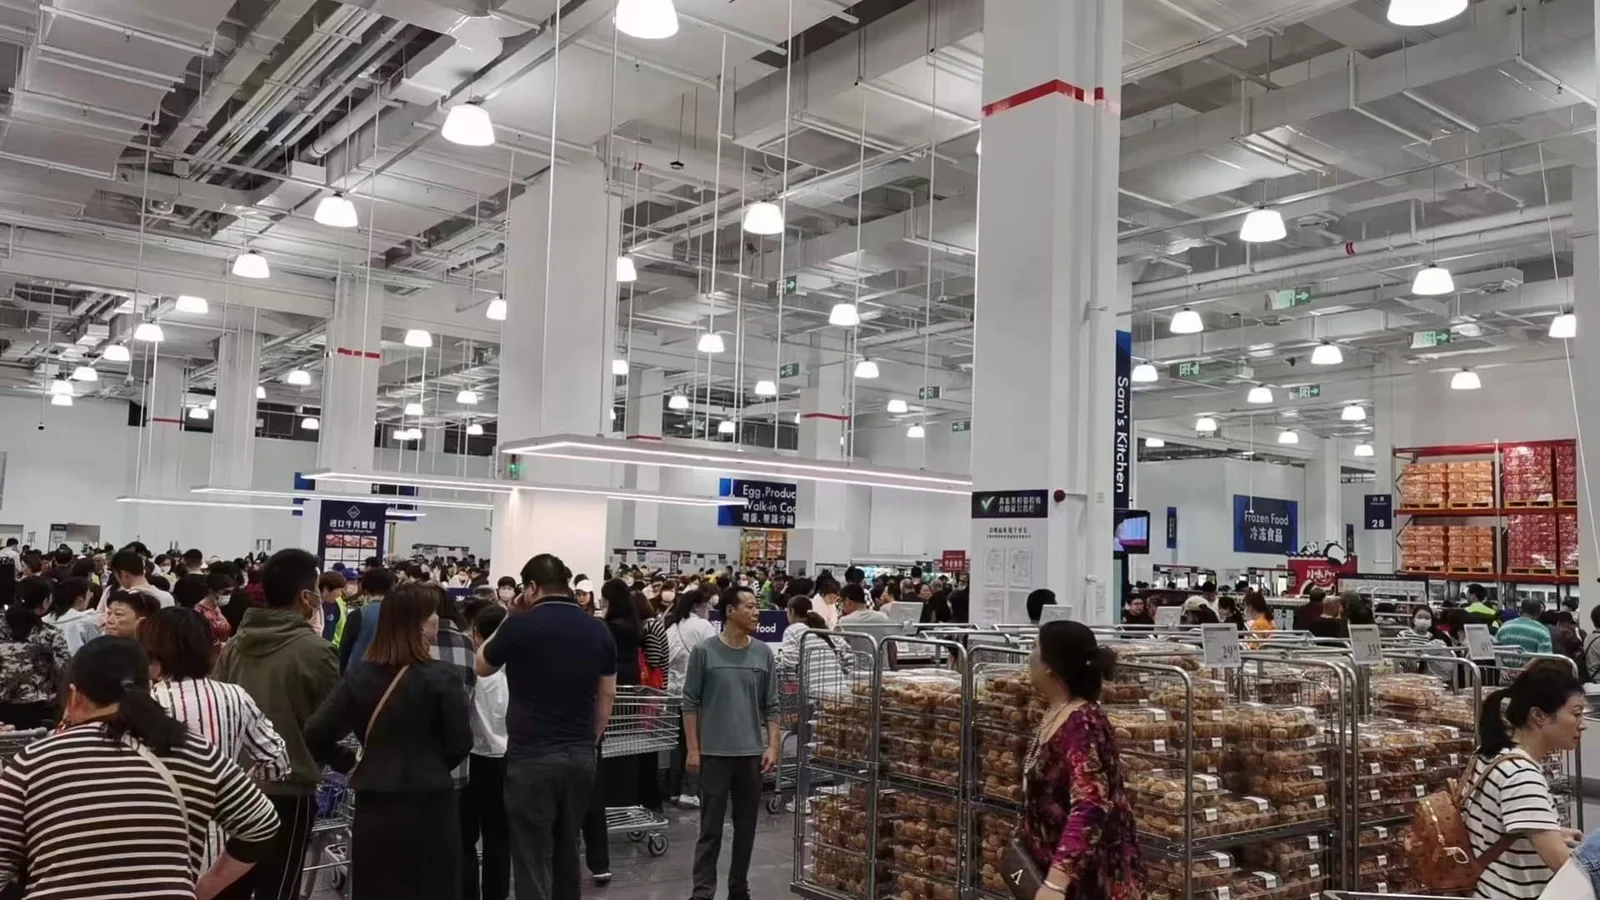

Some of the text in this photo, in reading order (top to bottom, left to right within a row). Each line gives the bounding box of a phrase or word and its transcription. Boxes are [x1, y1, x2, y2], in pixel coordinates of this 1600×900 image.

[1116, 376, 1129, 493] Sam's Kitchen
[1244, 510, 1289, 526] Frozen Food
[1372, 519, 1385, 528] 28
[1250, 526, 1283, 543] 冷冻食品
